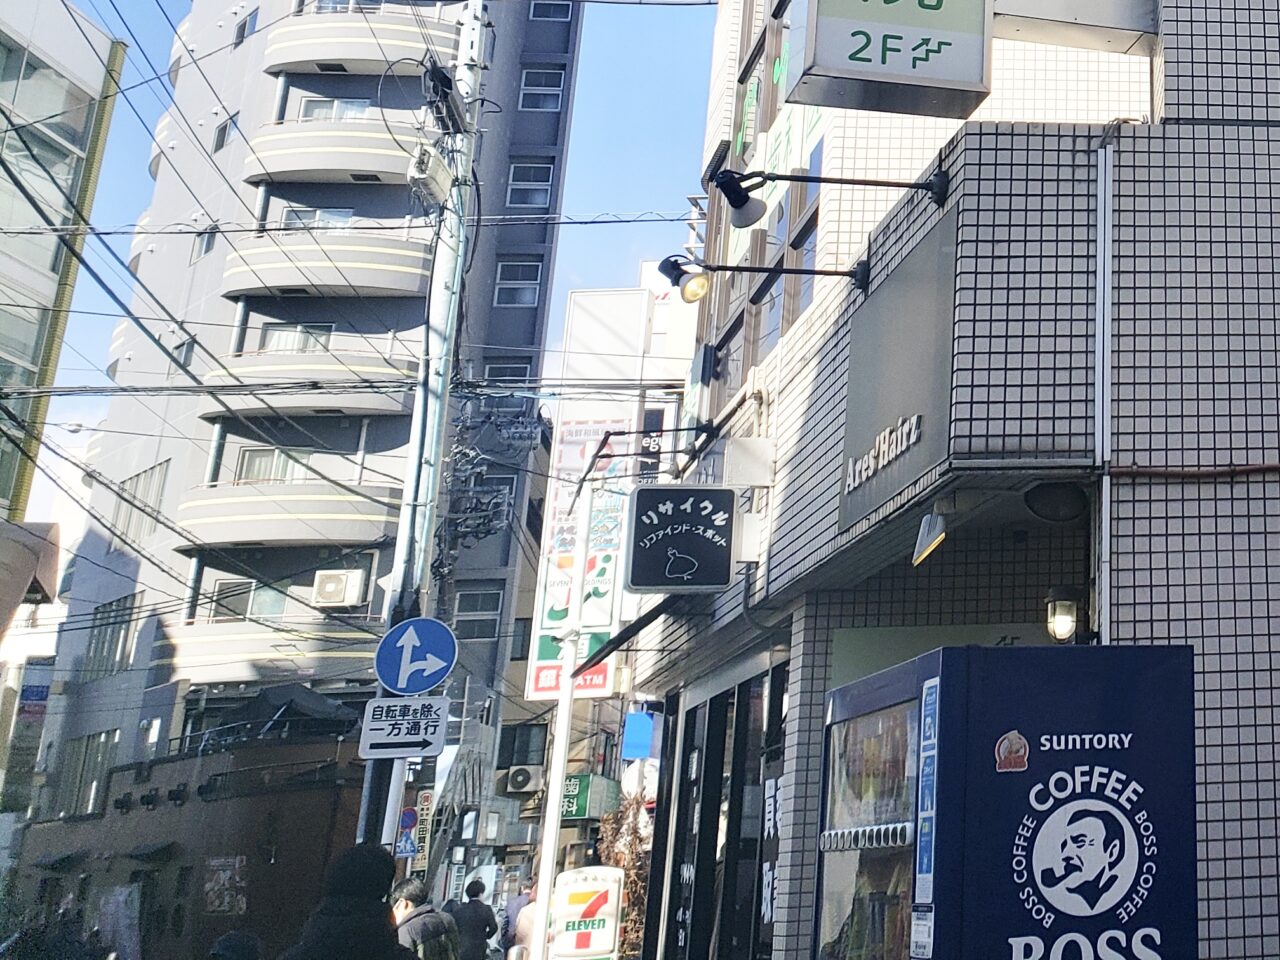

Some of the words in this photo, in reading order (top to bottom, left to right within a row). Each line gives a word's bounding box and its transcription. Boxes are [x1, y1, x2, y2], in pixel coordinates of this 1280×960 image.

[848, 30, 903, 65] 2F
[641, 497, 728, 526] リサイクル
[369, 721, 440, 737] 一方通行
[371, 702, 440, 720] 自転車を除く
[1040, 733, 1133, 751] SUNTORY
[1029, 765, 1144, 811] COFFEE
[1012, 814, 1037, 884] COFFEE
[1134, 810, 1158, 857] BOSS
[1019, 886, 1055, 929] BOSS
[1116, 861, 1158, 924] COFFEE
